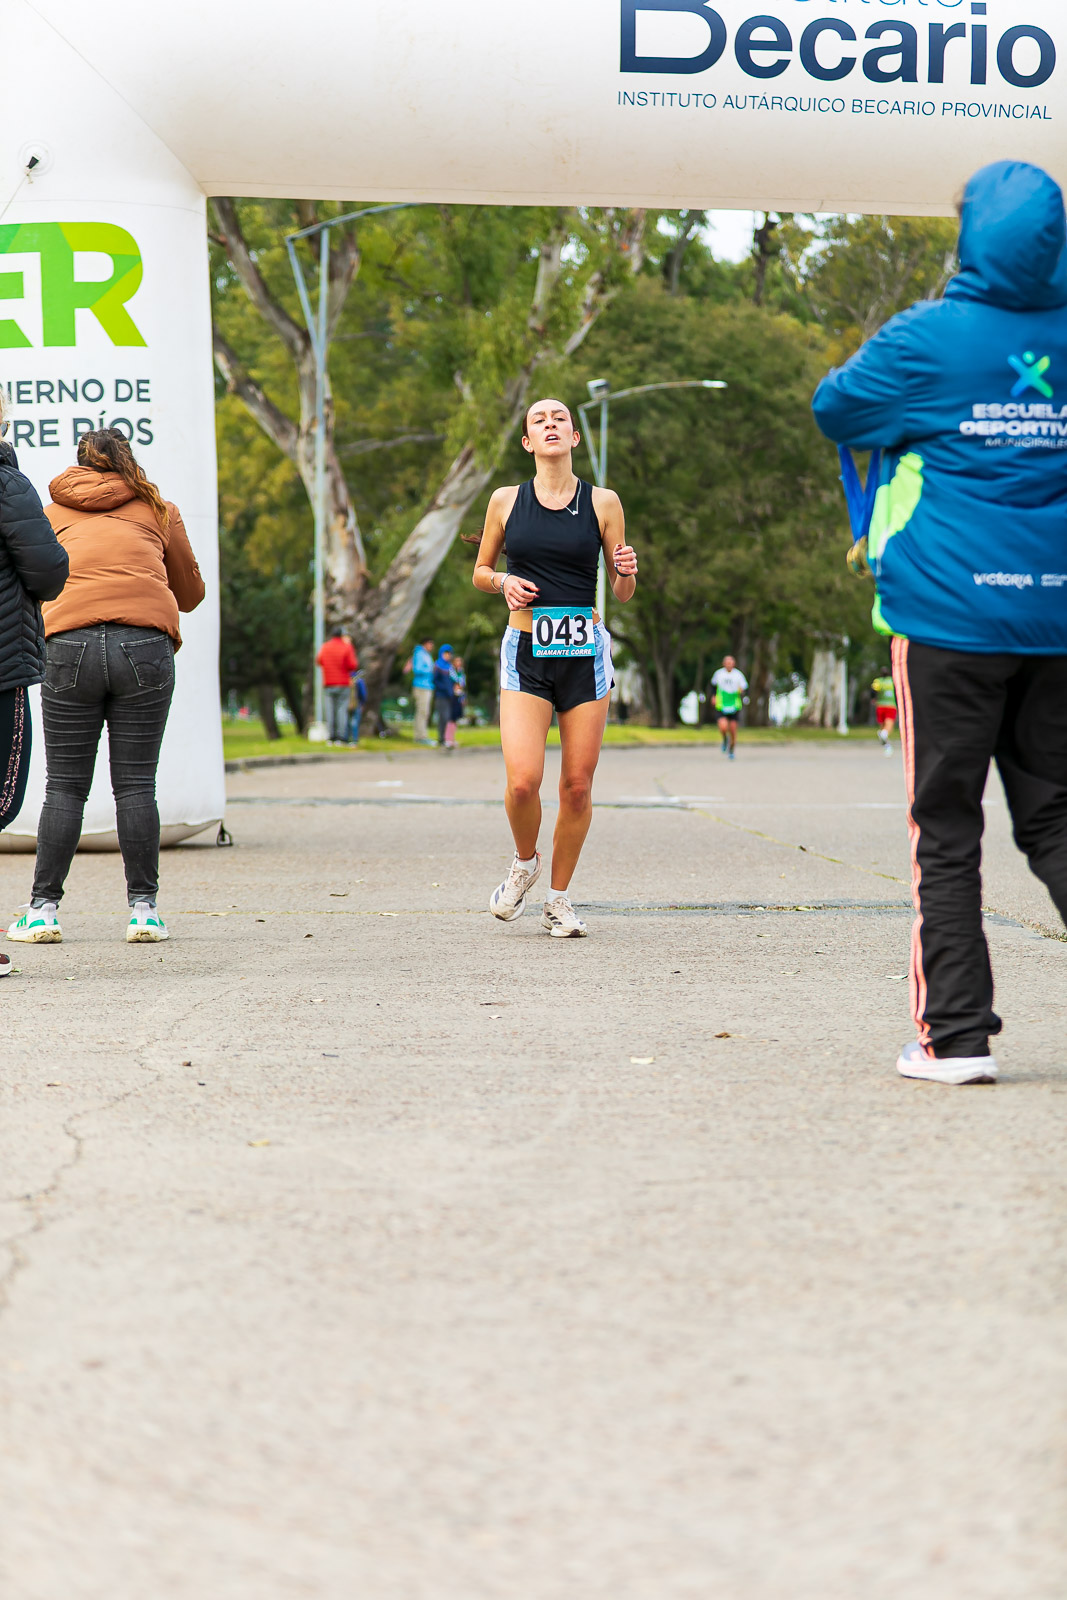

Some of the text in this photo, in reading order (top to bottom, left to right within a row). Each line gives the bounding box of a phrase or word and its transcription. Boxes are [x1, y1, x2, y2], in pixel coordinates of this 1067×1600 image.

[617, 90, 1053, 120] INSTITUTO AUTÁRQUICO BECARIO PROVINCIAL
[0, 378, 151, 405] IERNO DE
[5, 418, 60, 448] RE
[536, 613, 588, 648] 043
